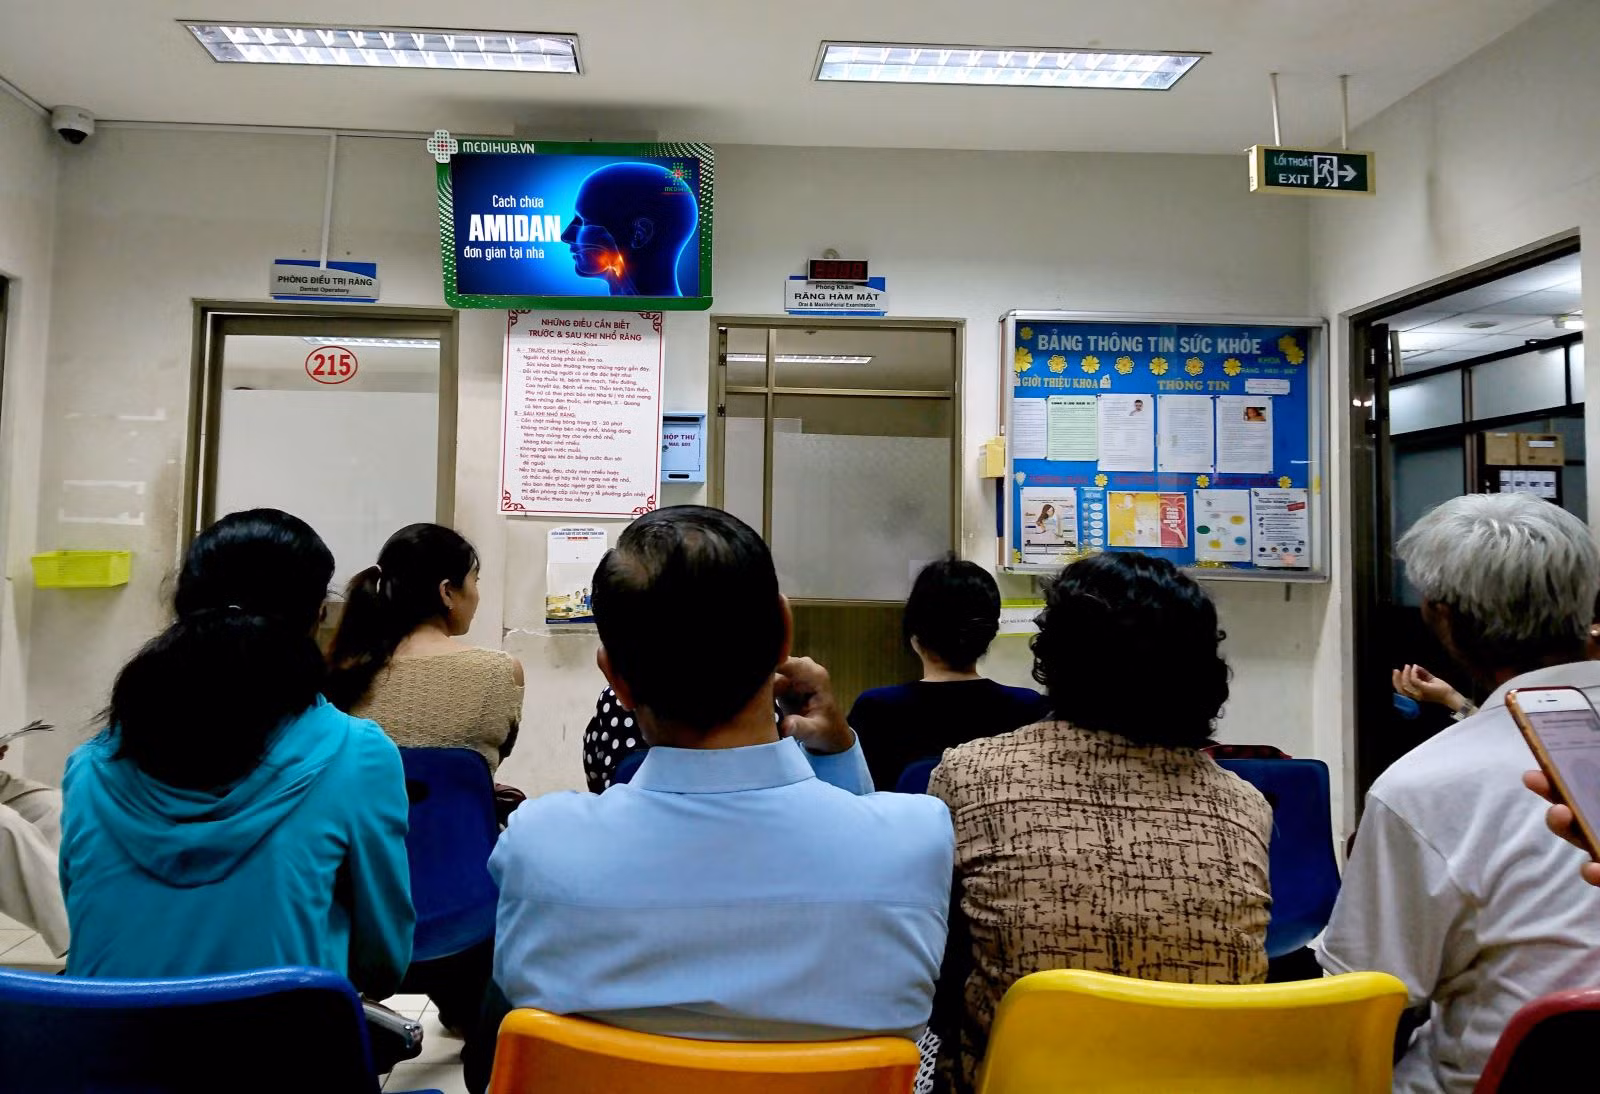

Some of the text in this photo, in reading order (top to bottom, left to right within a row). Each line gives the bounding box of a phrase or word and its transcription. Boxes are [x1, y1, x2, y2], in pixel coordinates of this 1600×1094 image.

[463, 142, 535, 154] MEDIHUB.VN
[1279, 173, 1310, 184] EXIT
[469, 214, 561, 242] AMIDAN
[278, 275, 308, 284] PHÒNG
[795, 291, 880, 302] RĂNG HÀM MẶT
[1038, 328, 1261, 354] BẢNG THÔNG TIN SỨC KHỎE
[313, 354, 351, 376] 215
[1072, 378, 1098, 389] KHOA
[1206, 380, 1230, 391] TIN
